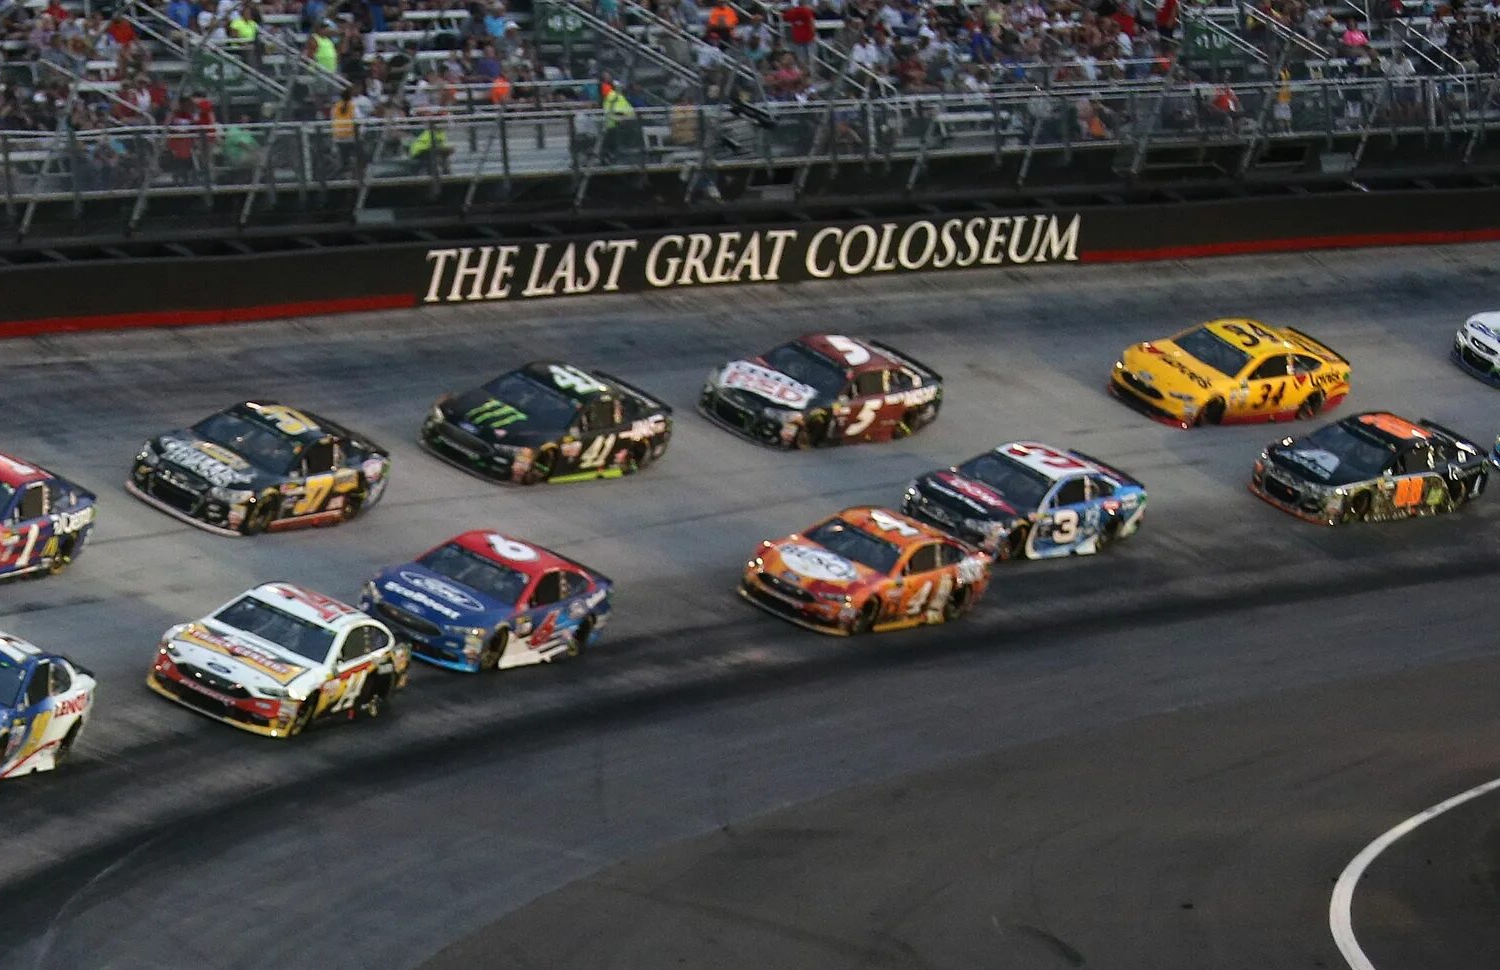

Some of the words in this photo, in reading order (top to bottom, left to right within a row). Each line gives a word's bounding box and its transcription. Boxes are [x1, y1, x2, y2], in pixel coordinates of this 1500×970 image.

[424, 248, 519, 302] THE
[522, 238, 637, 297] LAST
[645, 229, 798, 287] GREAT
[805, 213, 1083, 279] COLOSSEUM
[1052, 509, 1079, 544] 3
[486, 535, 538, 561] 6
